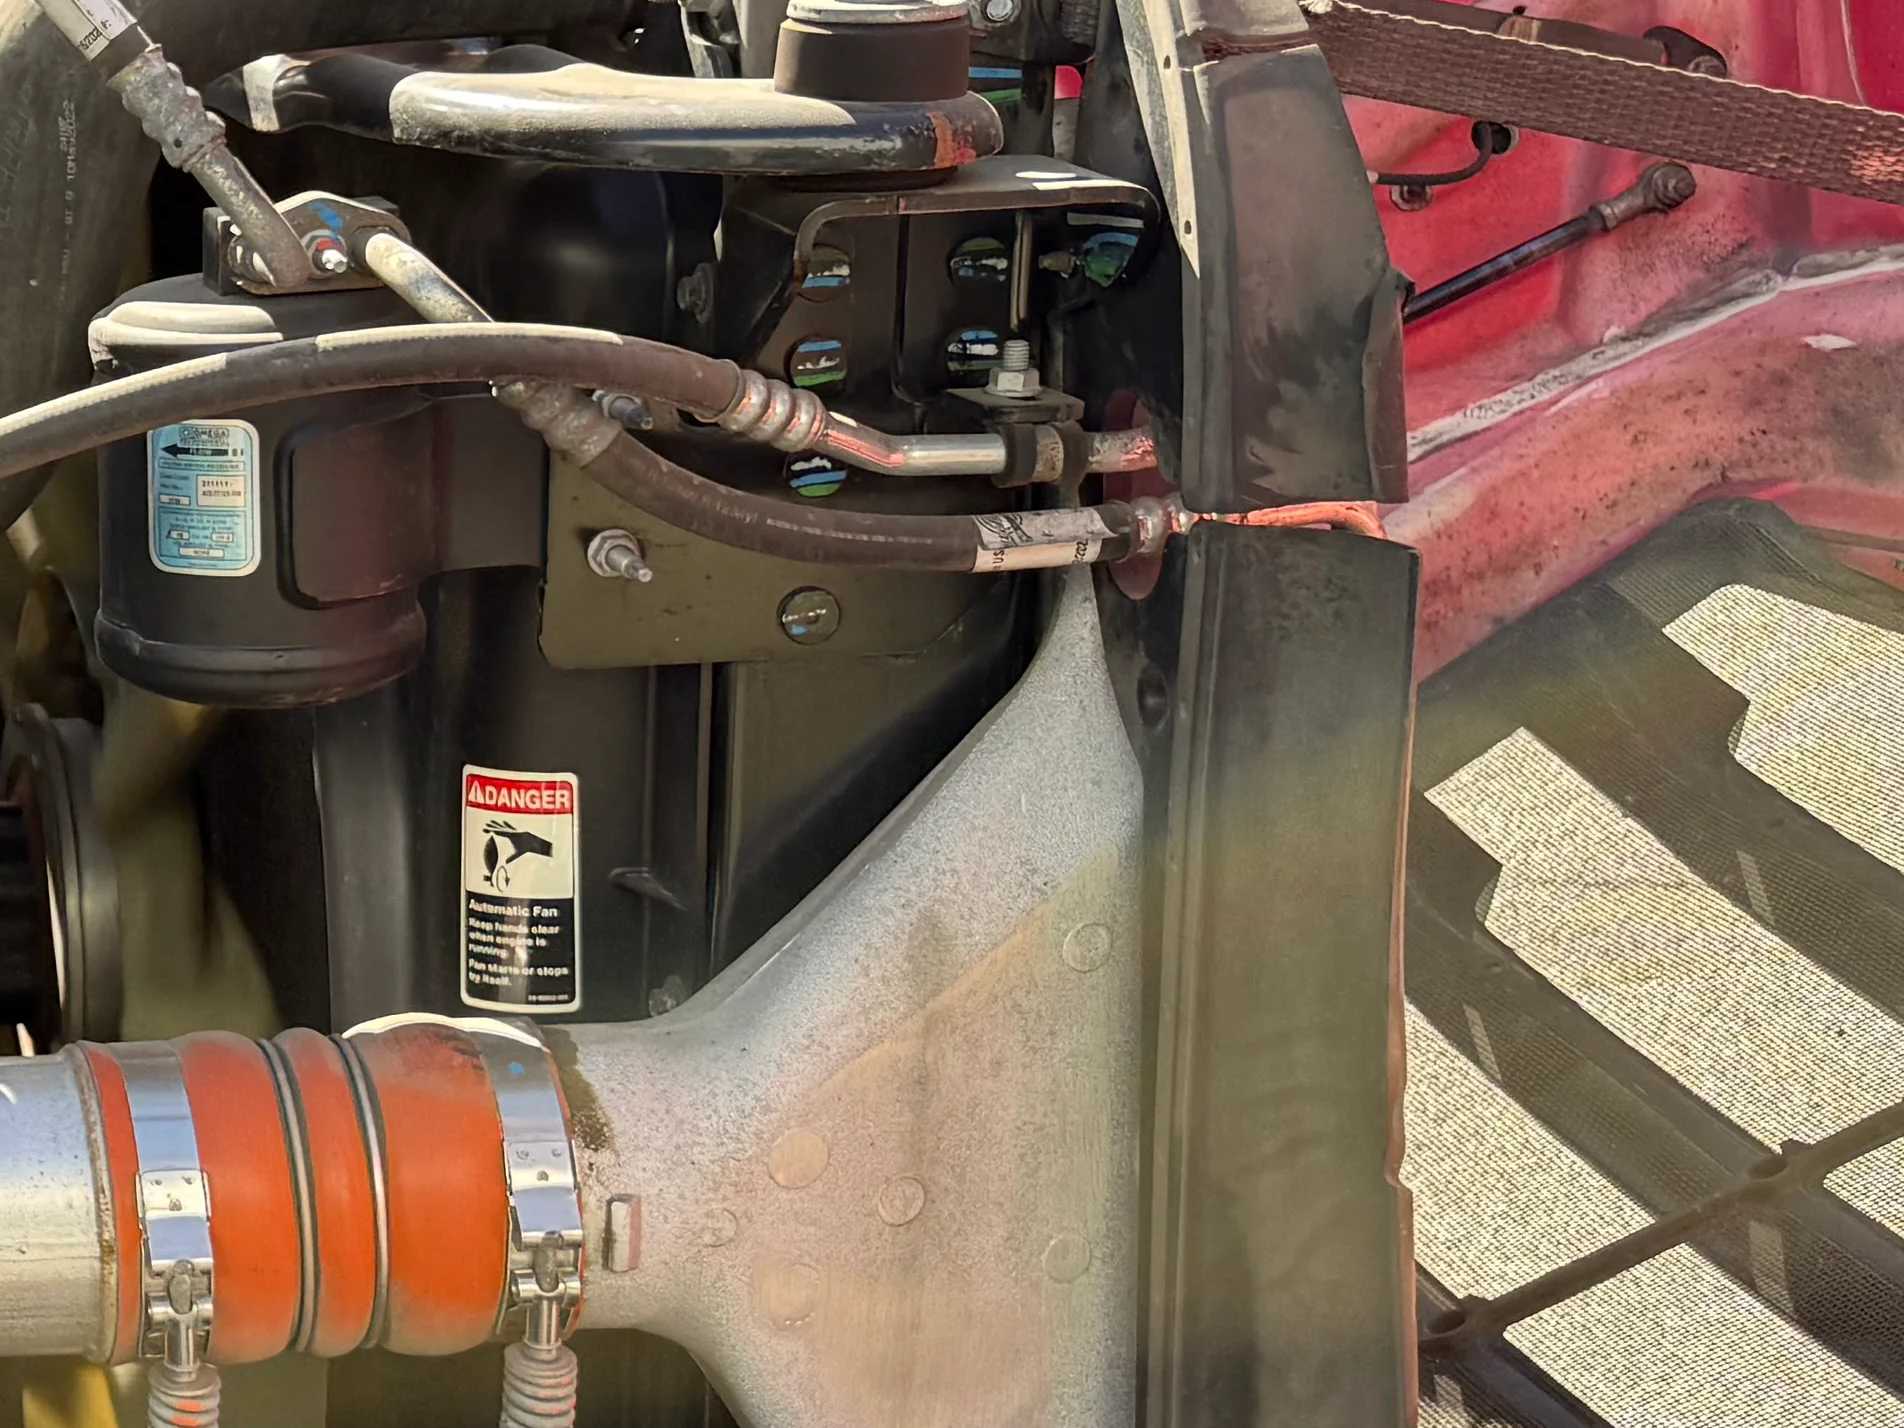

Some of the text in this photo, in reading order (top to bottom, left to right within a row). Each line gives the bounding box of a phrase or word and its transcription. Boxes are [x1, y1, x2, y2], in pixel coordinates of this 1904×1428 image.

[484, 785, 571, 811] DANGER
[469, 898, 558, 917] Automatic Fan
[495, 922, 529, 934] hands
[532, 924, 560, 935] clear
[536, 936, 547, 947] is
[469, 958, 569, 977] Fan starts or stops
[469, 971, 481, 984] by
